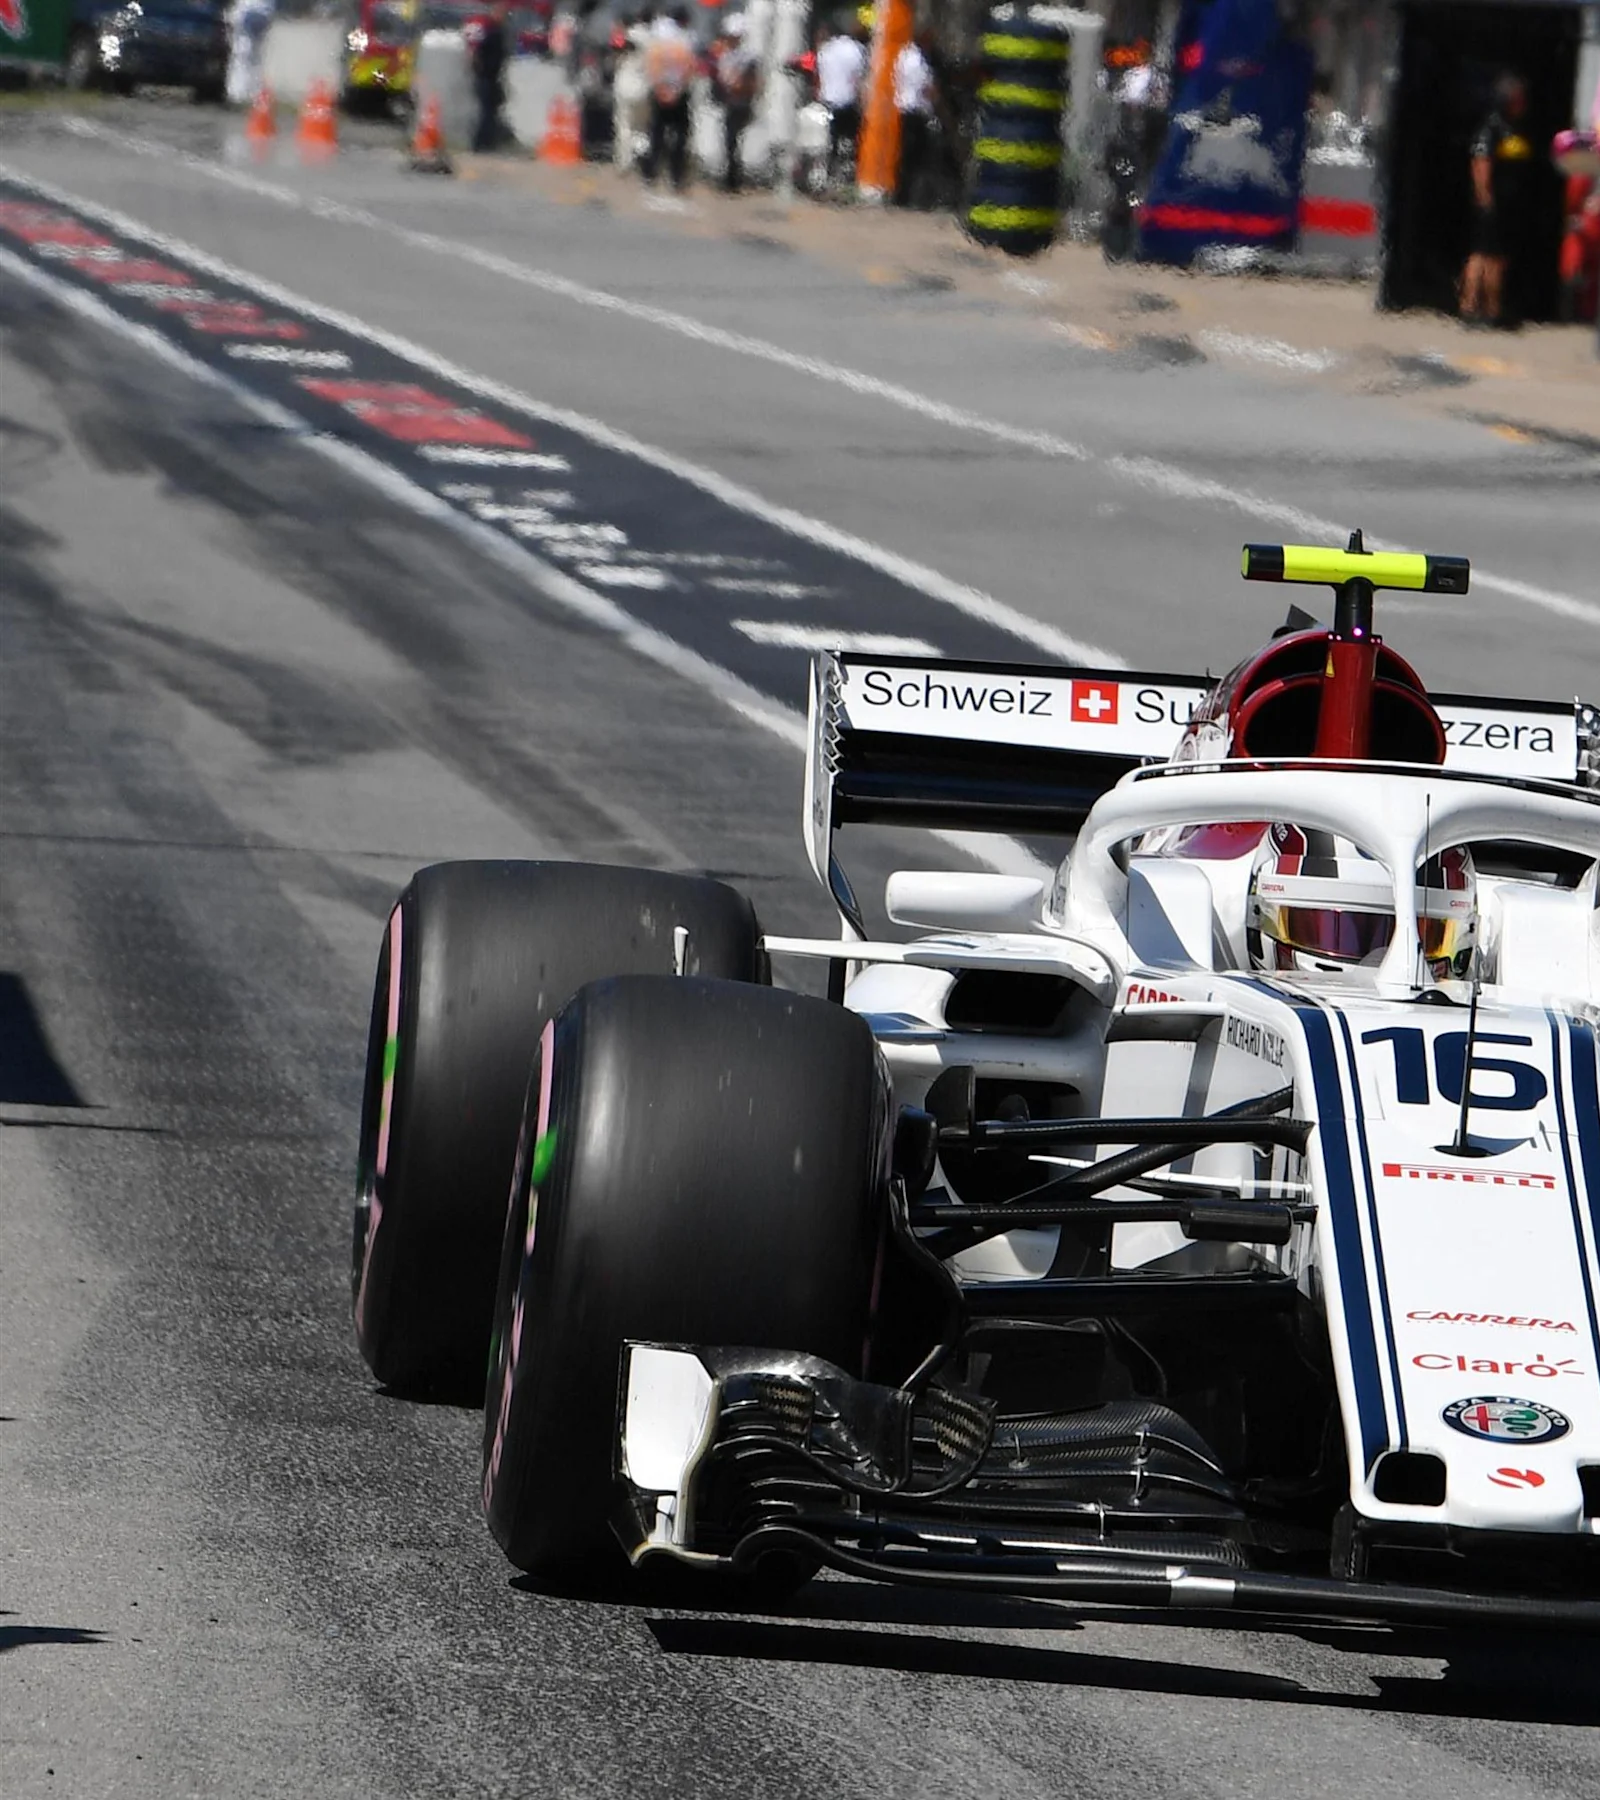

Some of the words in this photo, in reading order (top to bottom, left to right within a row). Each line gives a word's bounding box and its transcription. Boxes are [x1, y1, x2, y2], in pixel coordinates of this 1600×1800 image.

[861, 670, 1053, 717] Schweiz
[1134, 689, 1205, 726] Su
[1227, 1015, 1261, 1058] RICHARD
[1361, 1026, 1548, 1111] 16
[1382, 1163, 1556, 1190] PIRELLI
[1406, 1311, 1578, 1332] CARRERA
[1412, 1353, 1558, 1378] Claro
[1446, 1398, 1486, 1418] ALFA
[1496, 1396, 1567, 1428] ROMEO
